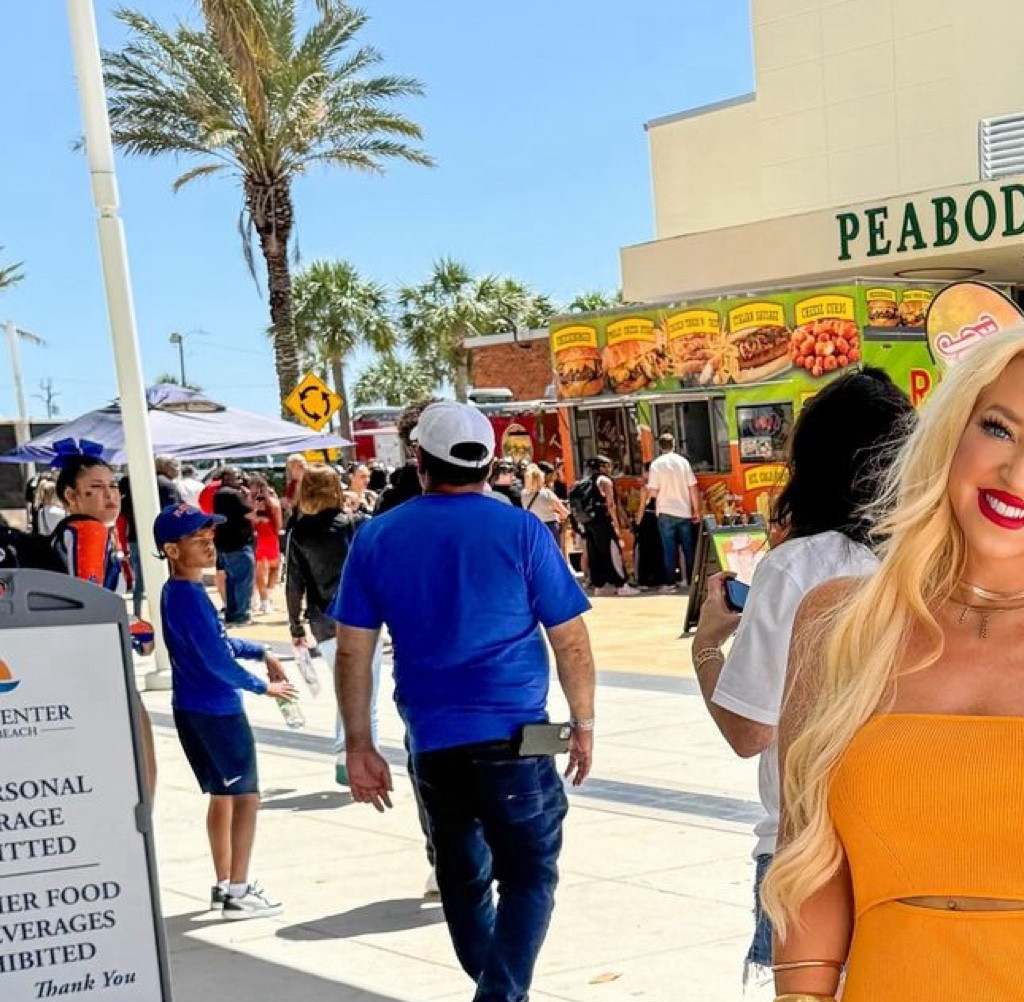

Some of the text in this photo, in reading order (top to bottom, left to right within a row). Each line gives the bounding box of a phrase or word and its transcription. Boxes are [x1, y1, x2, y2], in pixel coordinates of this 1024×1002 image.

[0, 775, 93, 802] SONAL
[46, 881, 121, 907] FOOD
[0, 909, 117, 943] VERAGES
[34, 969, 136, 1000] Thank You
